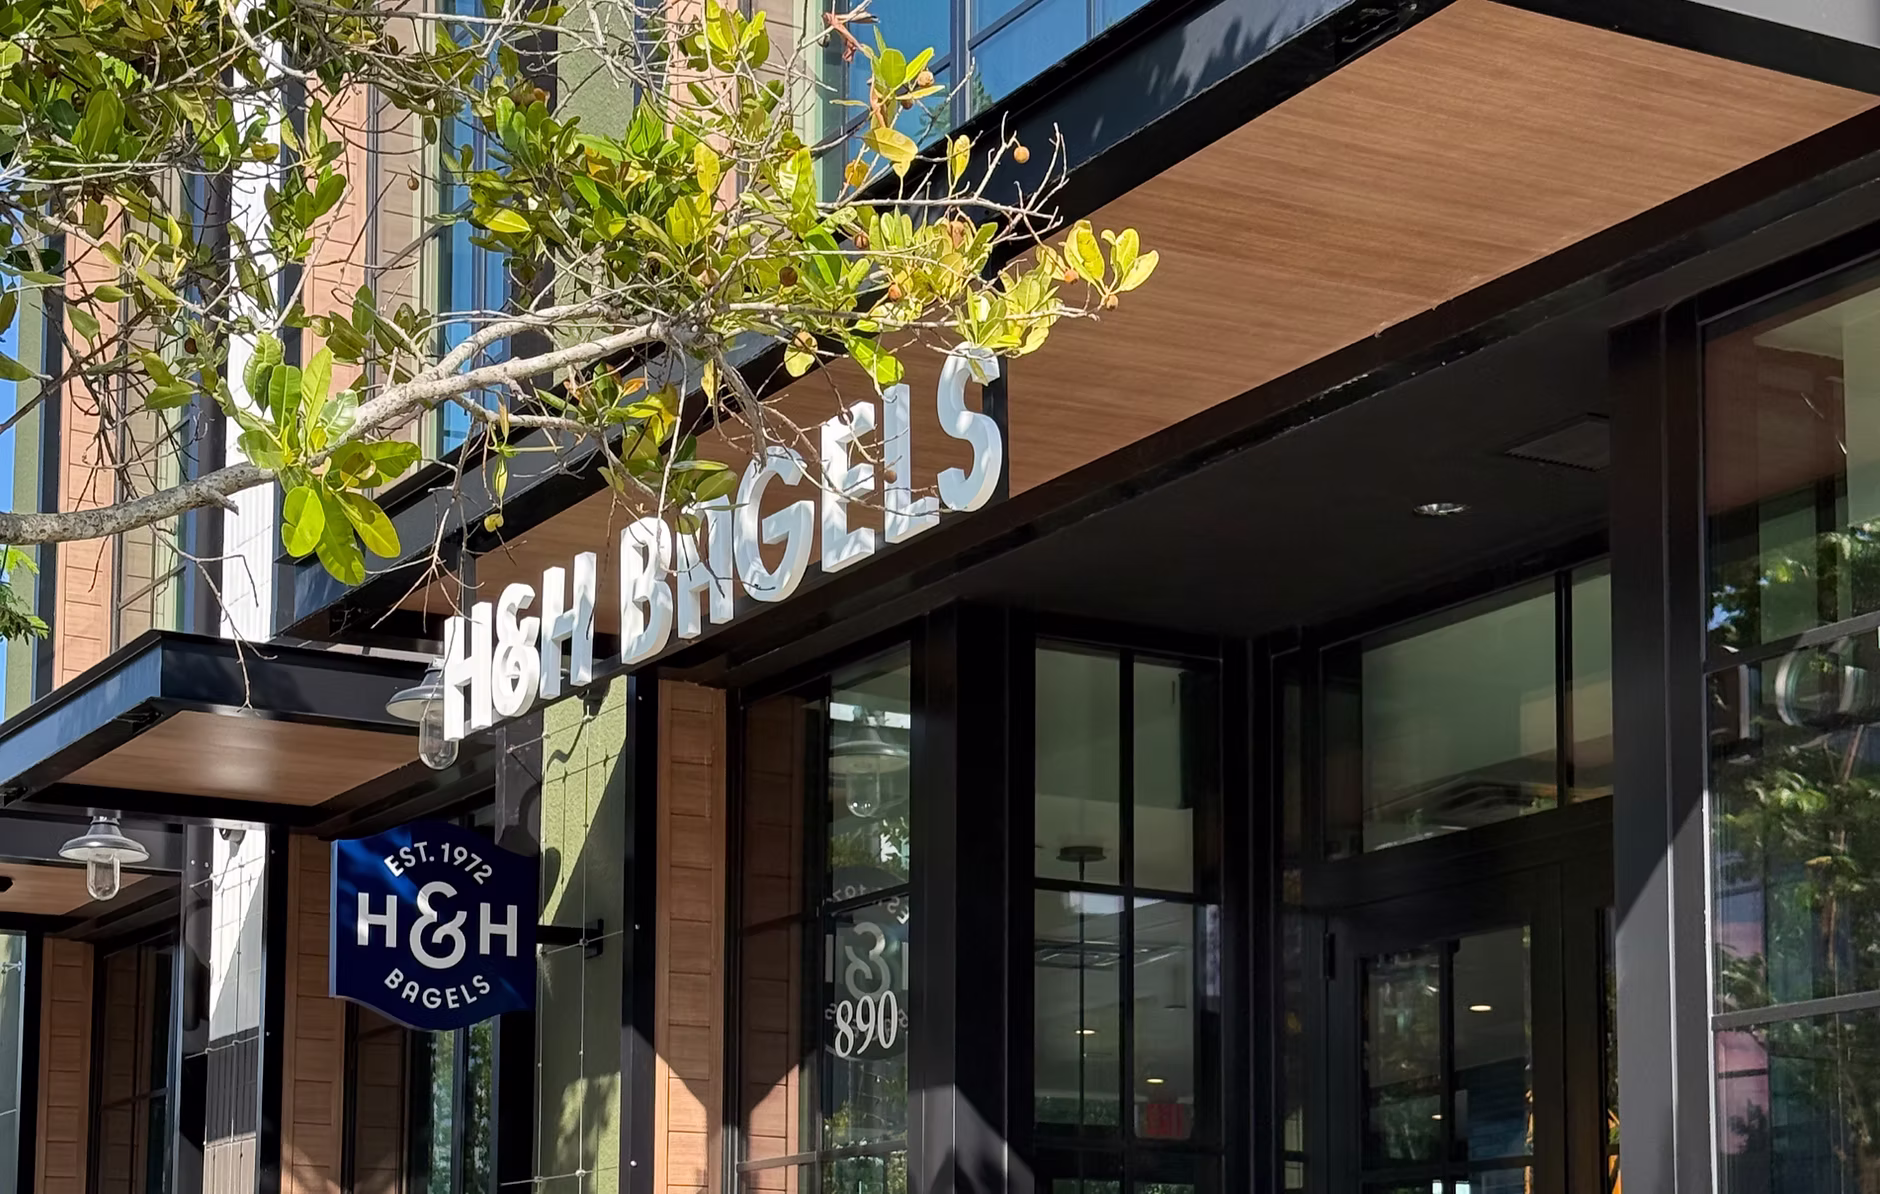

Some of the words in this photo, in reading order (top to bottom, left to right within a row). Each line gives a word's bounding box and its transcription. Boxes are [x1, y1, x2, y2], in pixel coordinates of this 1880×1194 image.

[444, 551, 597, 742] H&H
[620, 341, 1003, 665] BAGELS
[384, 841, 434, 877] EST.
[441, 842, 493, 885] 1972
[384, 968, 490, 1009] BAGELS
[835, 990, 898, 1058] 890
